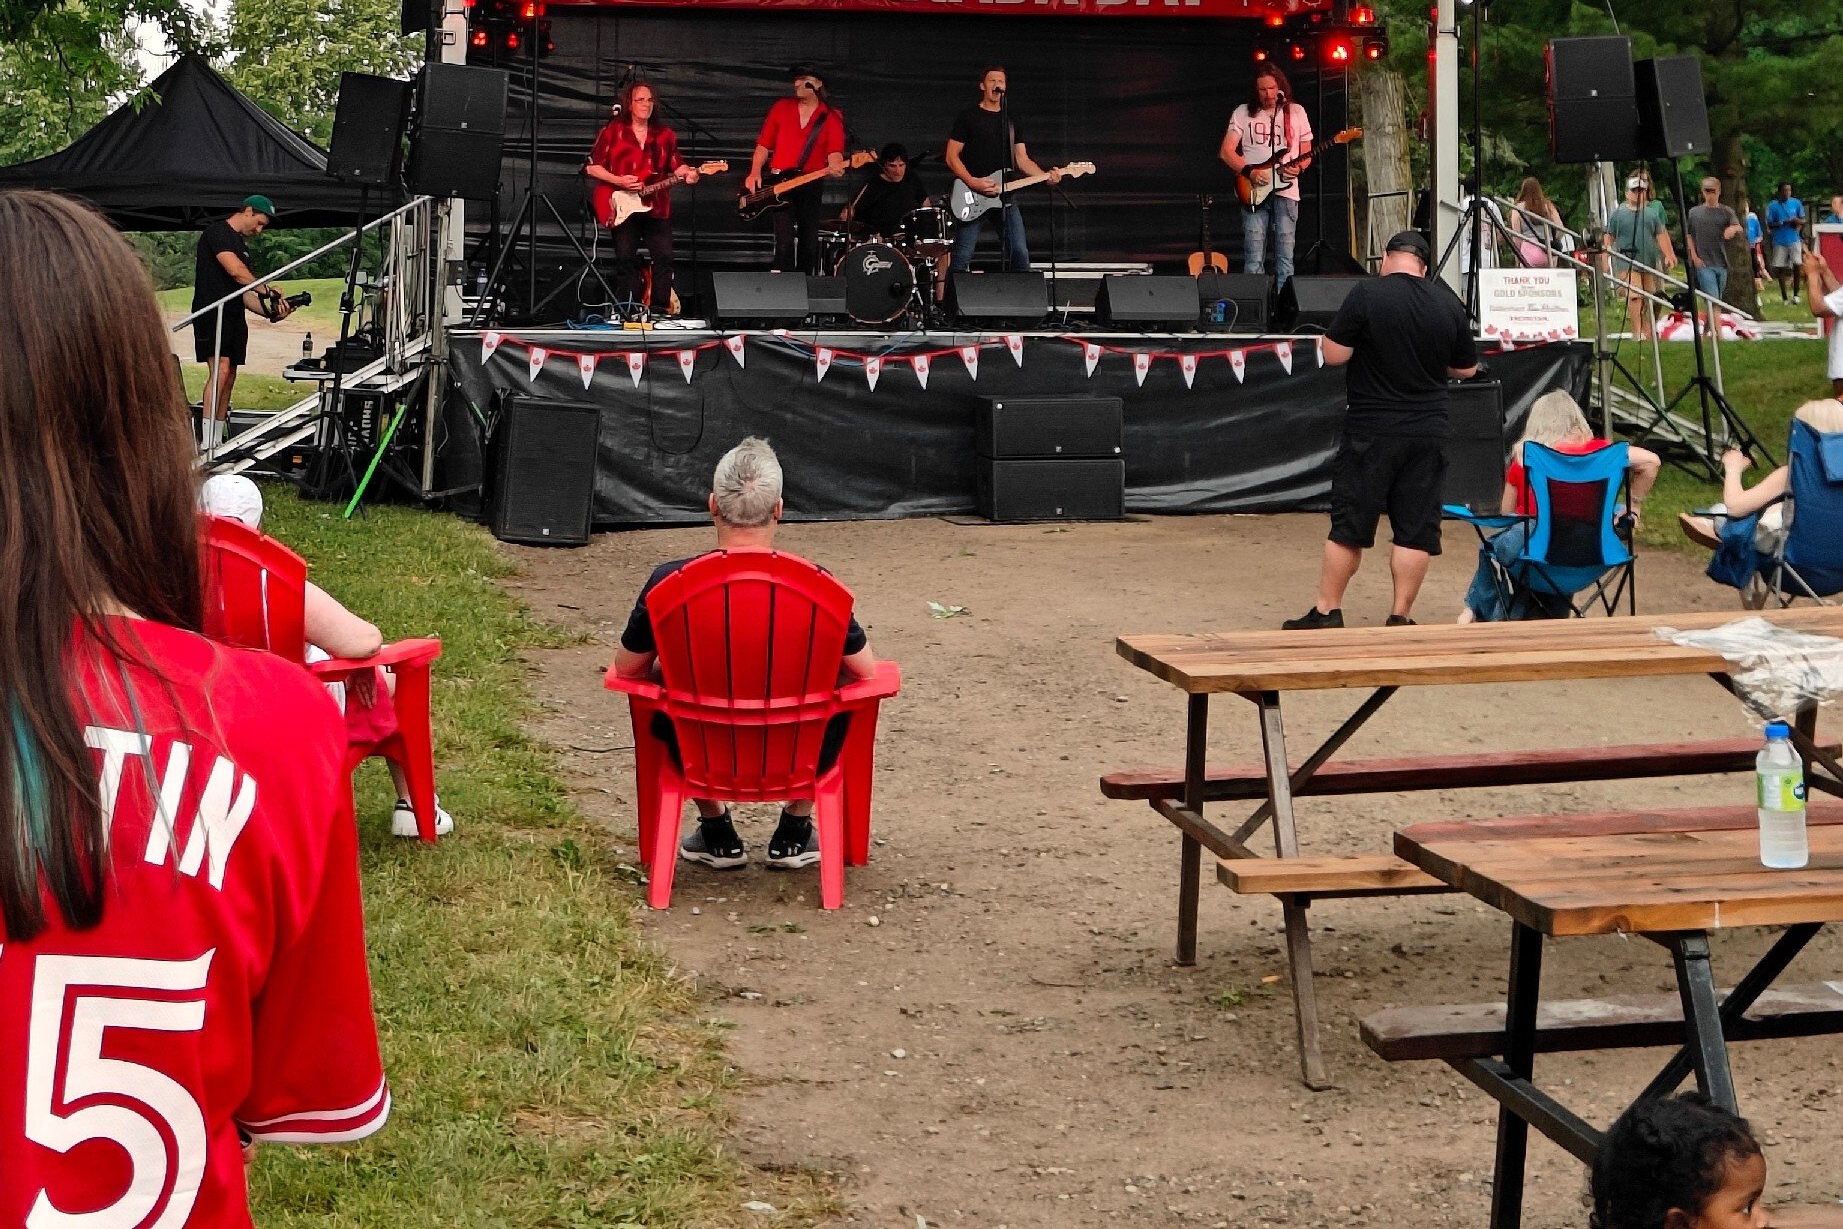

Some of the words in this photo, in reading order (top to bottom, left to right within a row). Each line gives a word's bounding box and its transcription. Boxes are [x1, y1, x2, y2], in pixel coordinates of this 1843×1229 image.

[1503, 276, 1530, 285] THANK
[1533, 276, 1550, 285] YOU
[1494, 289, 1515, 298] GOLD
